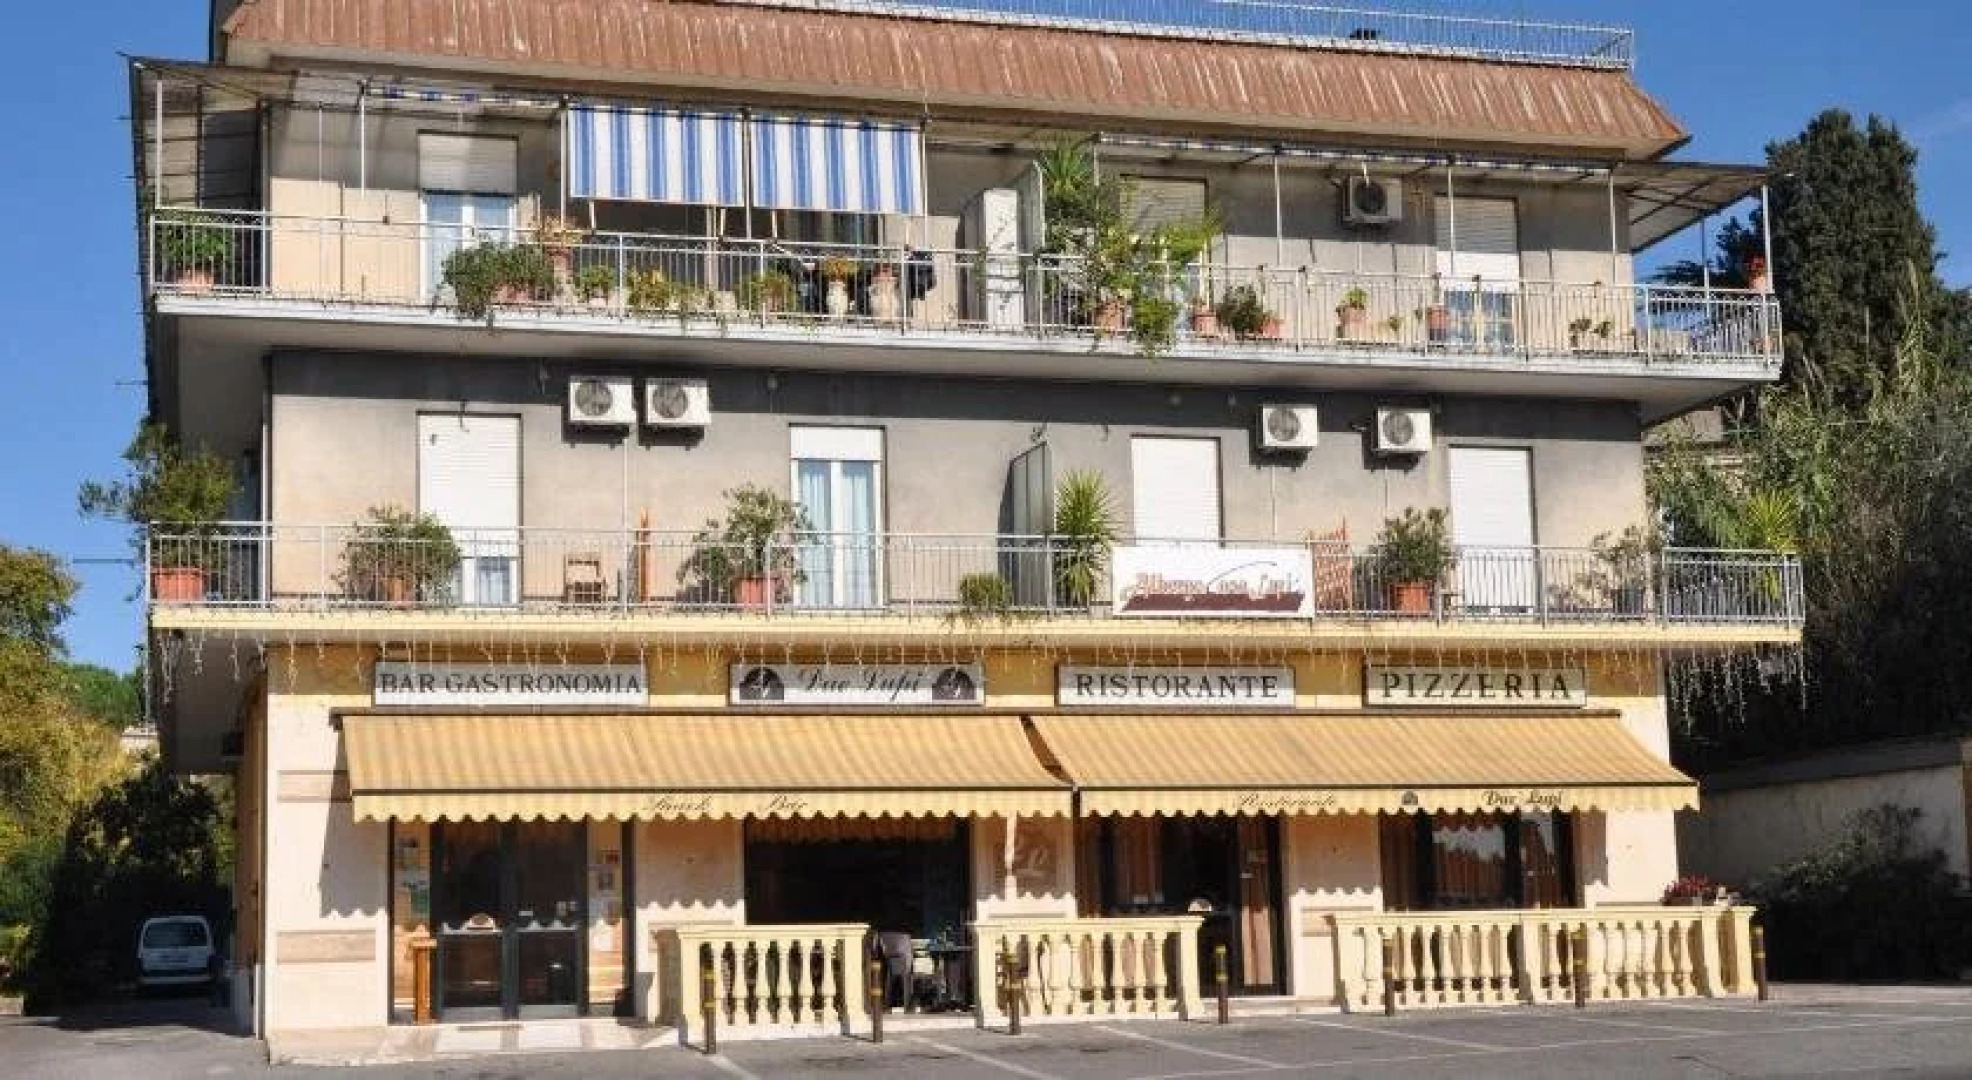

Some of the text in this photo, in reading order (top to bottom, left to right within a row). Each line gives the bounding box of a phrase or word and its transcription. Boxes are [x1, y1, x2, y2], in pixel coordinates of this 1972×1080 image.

[380, 673, 642, 693] BAR GASTRONOMIA
[798, 668, 924, 702] Due Lupi
[1074, 673, 1278, 698] RISTORANTE
[1380, 673, 1569, 698] PIZZERIA
